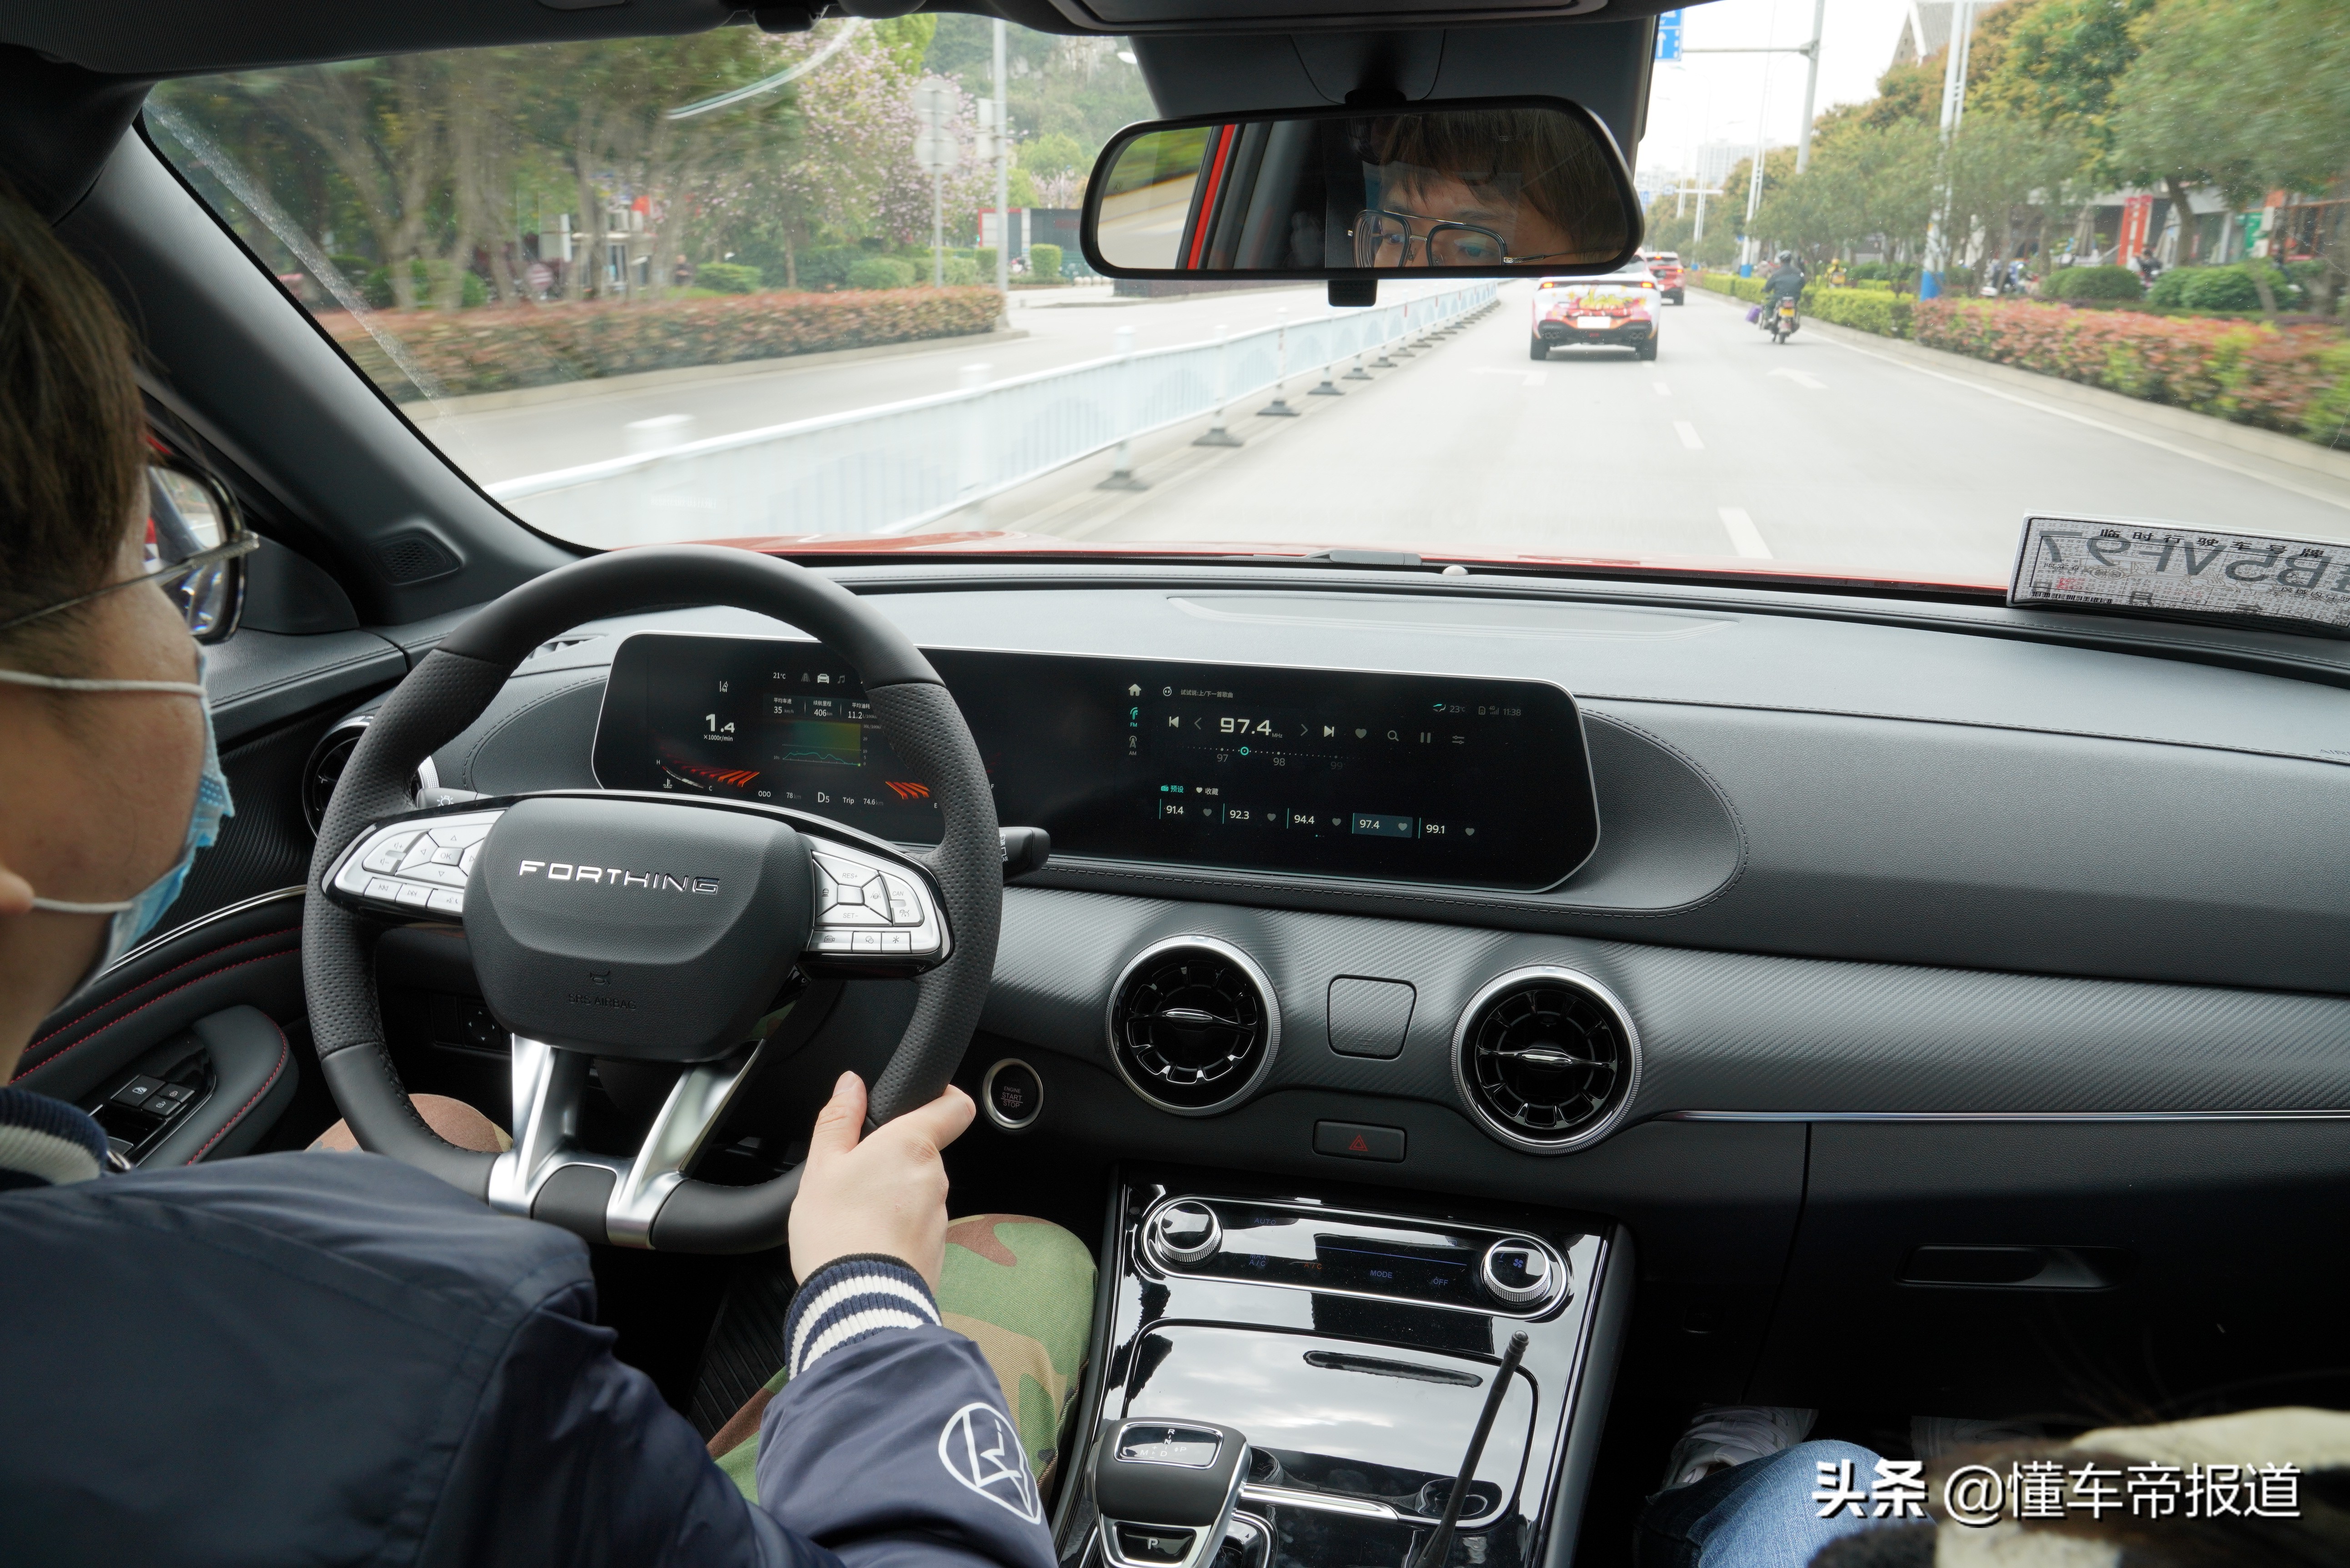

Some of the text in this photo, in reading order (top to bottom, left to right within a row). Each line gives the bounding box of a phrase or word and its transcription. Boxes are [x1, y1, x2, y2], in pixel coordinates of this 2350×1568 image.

[2100, 529, 2324, 558] 临时行驶车号牌
[1503, 708, 1521, 716] 11:38
[706, 714, 735, 733] 1.4
[1220, 717, 1272, 736] 97.4
[1217, 754, 1342, 769] 97 98 99
[1170, 785, 1219, 796] 预设 收藏
[817, 792, 830, 803] D5
[843, 797, 854, 805] Trip
[1166, 805, 1184, 814] 91.4
[1230, 810, 1250, 819] 92.3
[1294, 814, 1315, 824] 94.4
[1359, 819, 1380, 829] 97.4
[1426, 824, 1445, 834] 99.1
[519, 859, 720, 895] FORTHING
[569, 993, 636, 1010] SRS AIRBAG
[1002, 1092, 1023, 1101] START
[1003, 1100, 1020, 1108] STOP
[1370, 1270, 1393, 1278] MODE
[1433, 1277, 1448, 1286] OFF
[1148, 1538, 1159, 1549] P
